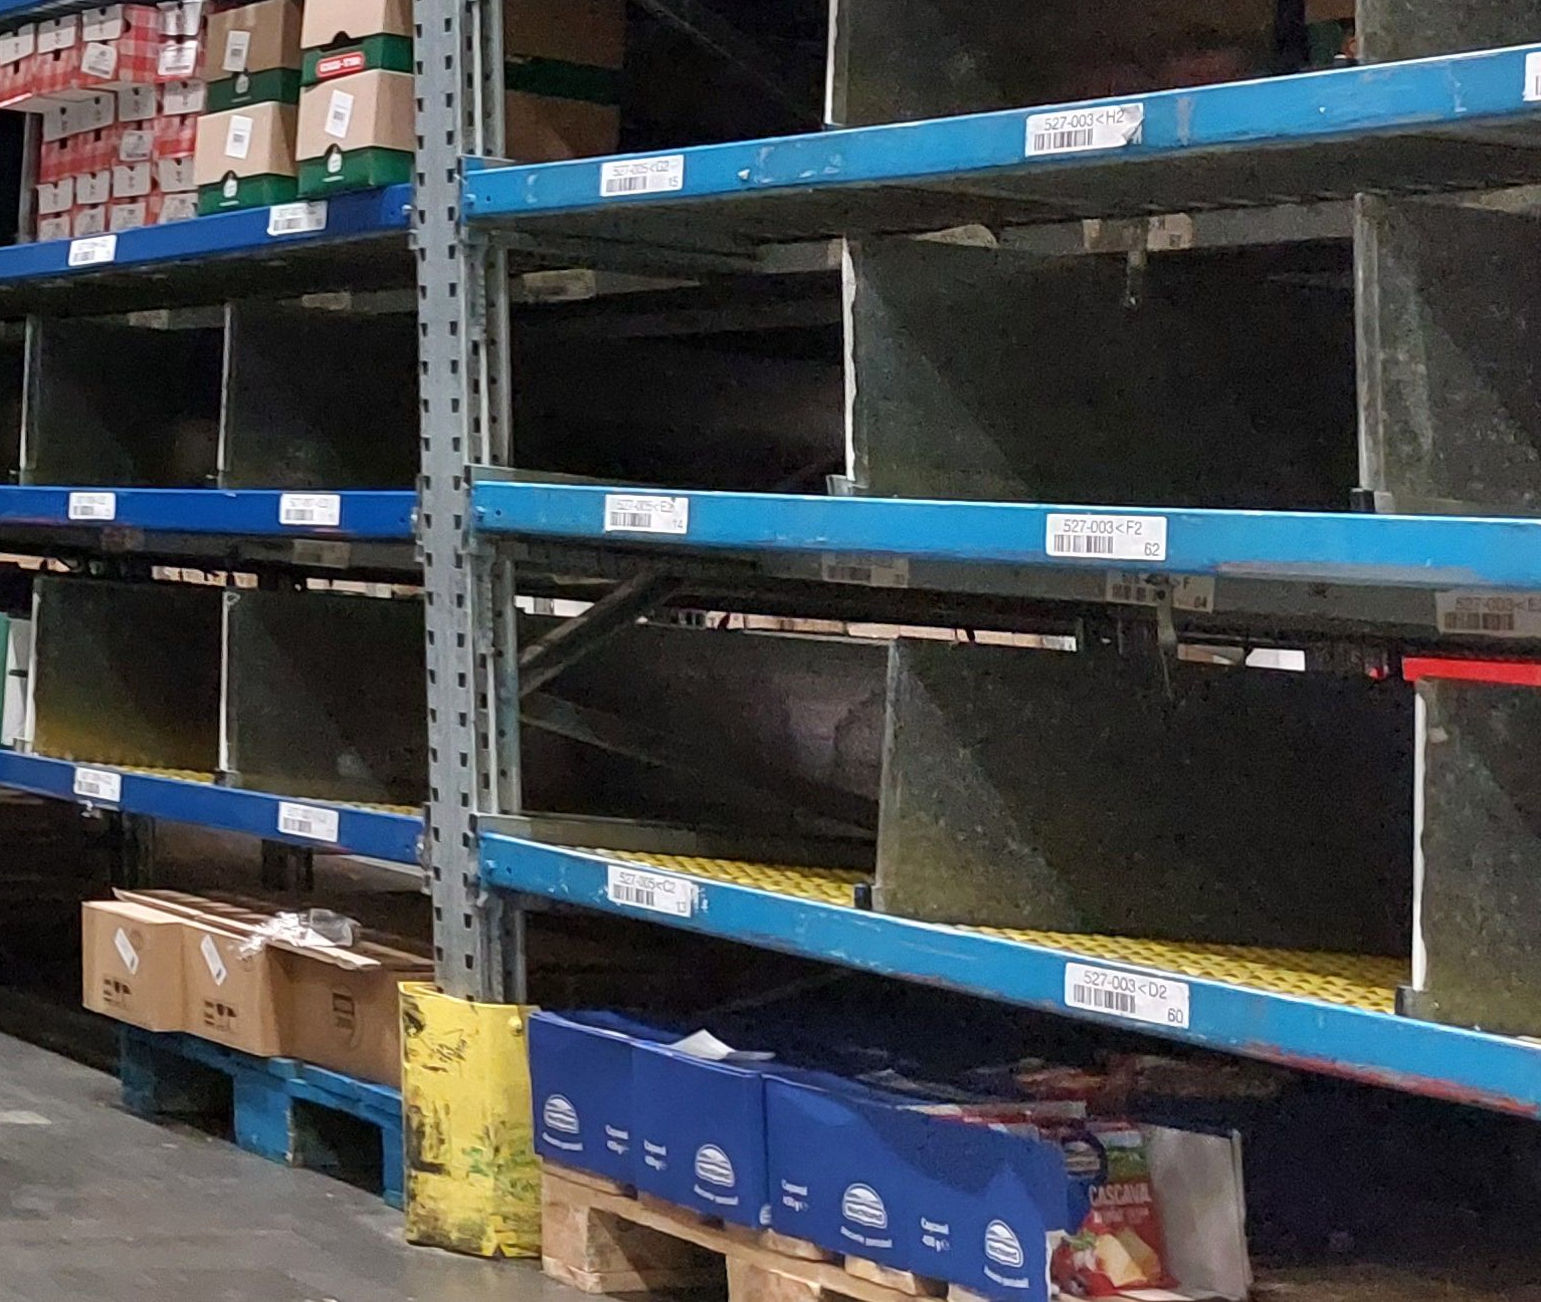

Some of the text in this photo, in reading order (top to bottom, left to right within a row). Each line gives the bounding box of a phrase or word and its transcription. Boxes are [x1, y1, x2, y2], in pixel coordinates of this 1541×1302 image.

[1044, 109, 1125, 131] 527-003<H2
[1063, 519, 1142, 535] 527-003<F2
[1144, 542, 1160, 556] 62
[1084, 970, 1167, 1000] 527-003<D2
[1168, 1008, 1184, 1024] 60
